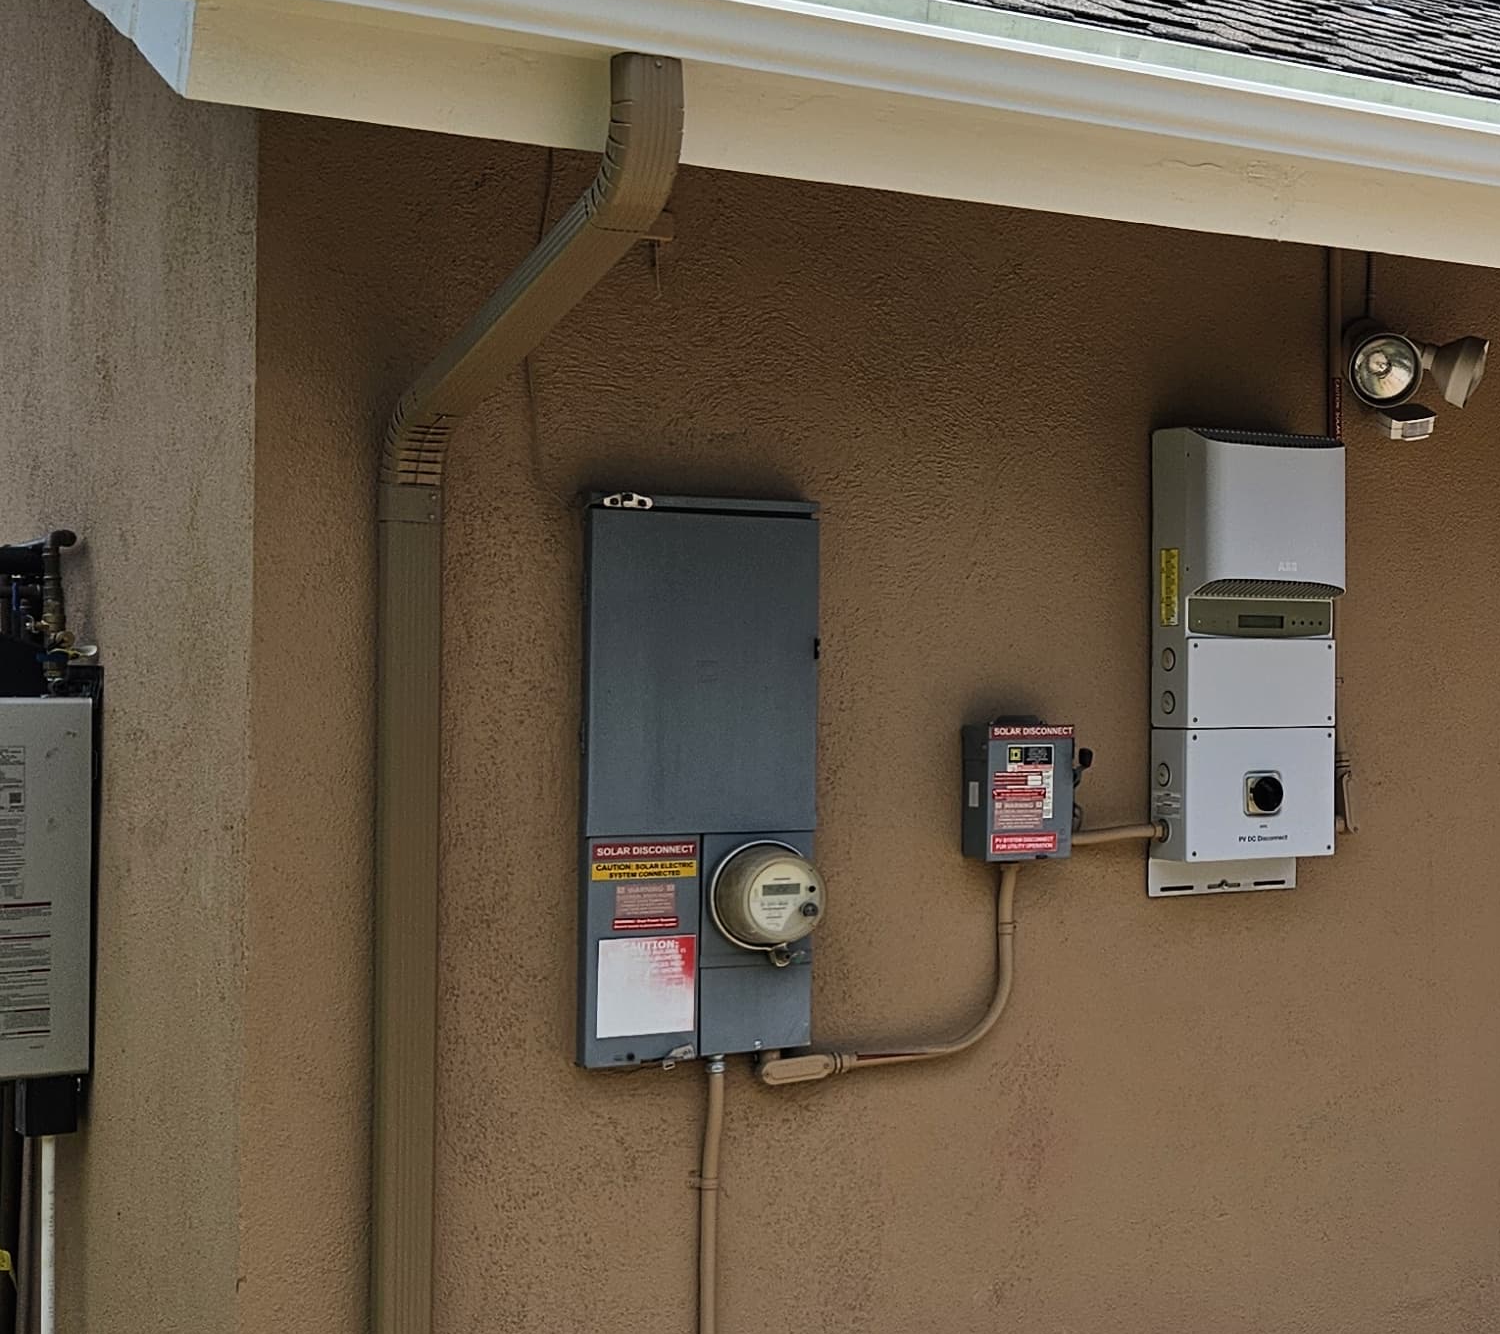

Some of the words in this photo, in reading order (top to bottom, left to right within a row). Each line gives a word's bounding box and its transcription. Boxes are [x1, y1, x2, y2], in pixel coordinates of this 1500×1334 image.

[994, 727, 1021, 736] SOLAR
[1023, 726, 1073, 736] DISCONNECT
[596, 847, 630, 857] SOLAR
[632, 845, 694, 855] DISCONNECT
